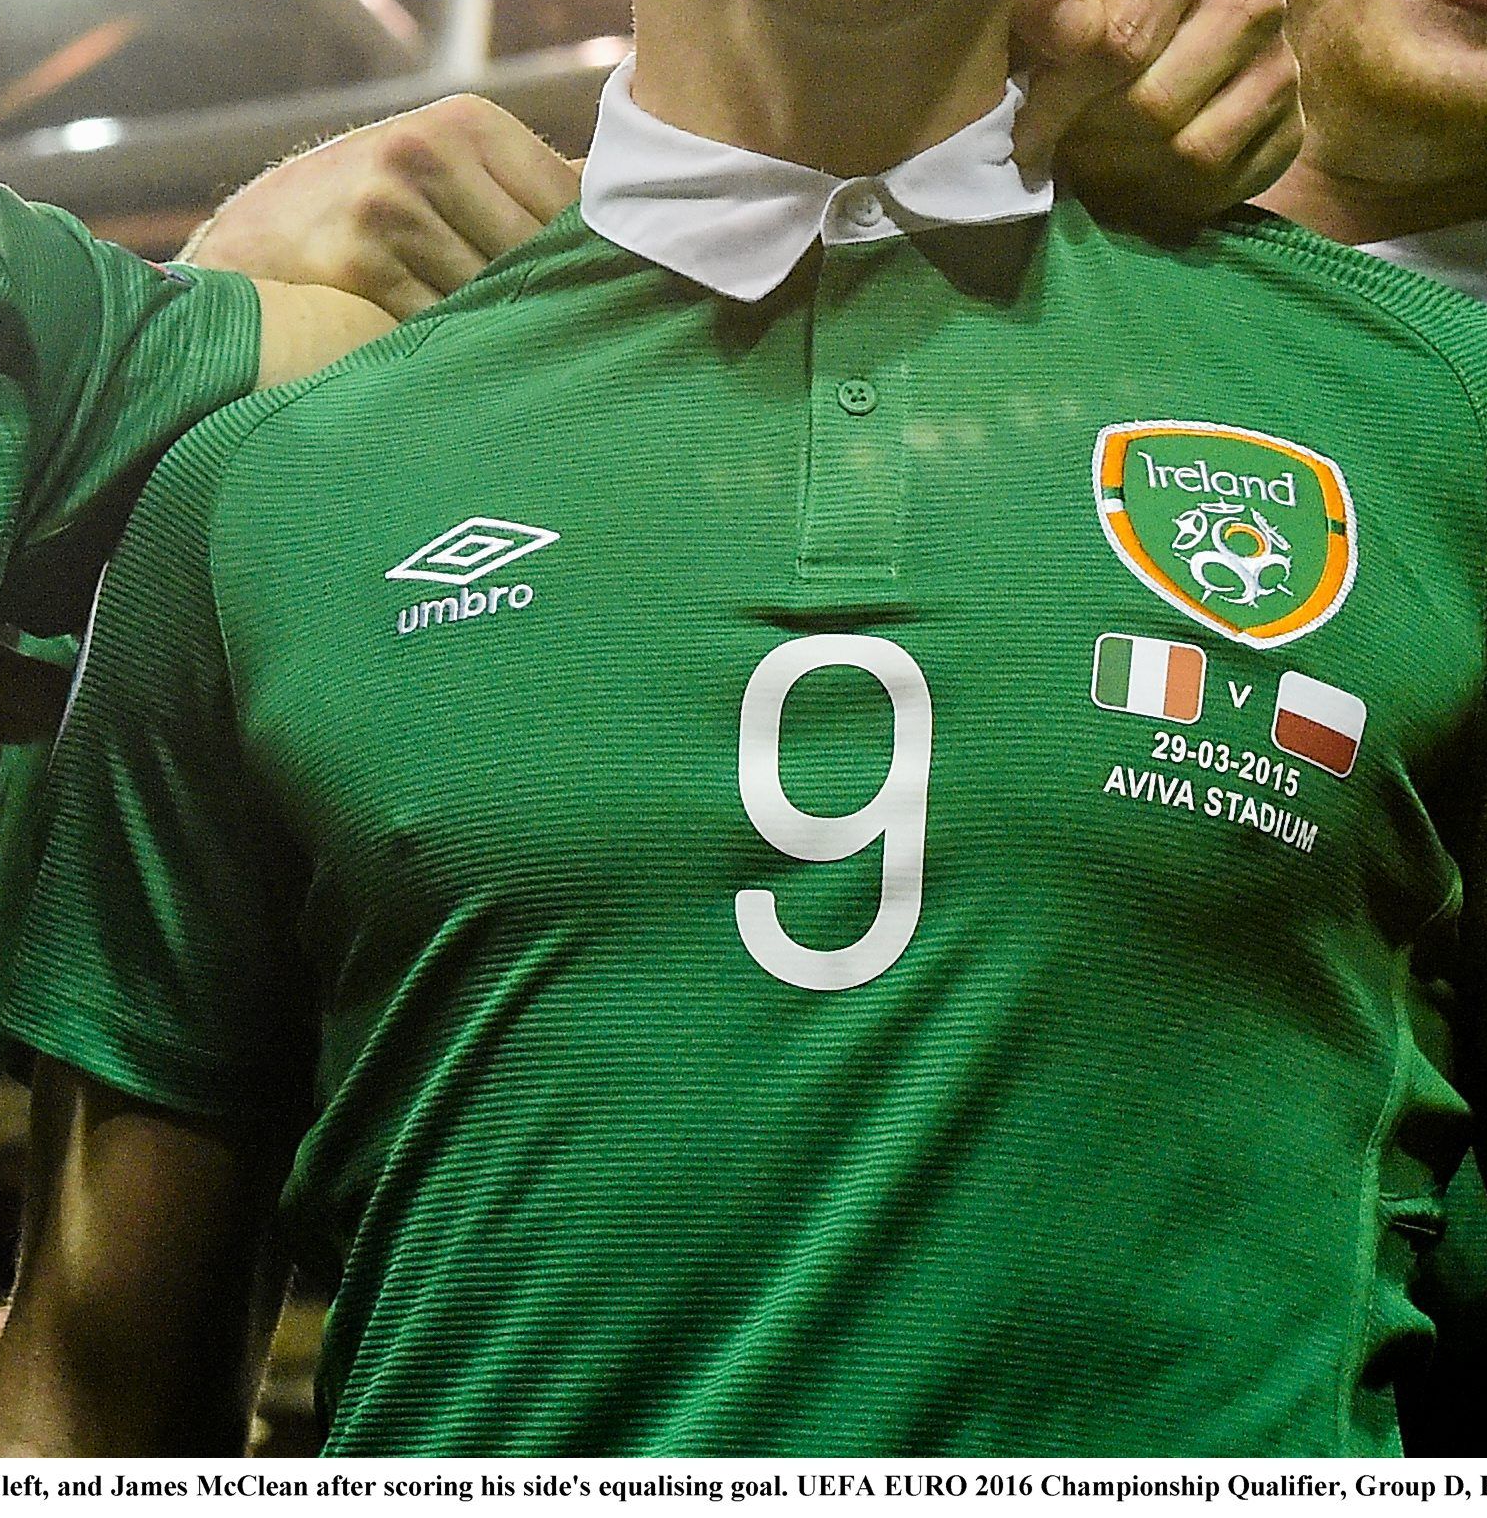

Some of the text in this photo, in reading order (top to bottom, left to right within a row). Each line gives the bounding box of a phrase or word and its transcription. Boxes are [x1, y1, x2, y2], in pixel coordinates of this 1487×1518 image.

[1137, 450, 1296, 508] Ireland
[396, 582, 534, 636] umbro
[1151, 731, 1301, 798] 29-03-2015
[735, 633, 933, 991] 9
[1103, 765, 1319, 854] AVIVA STADIUM
